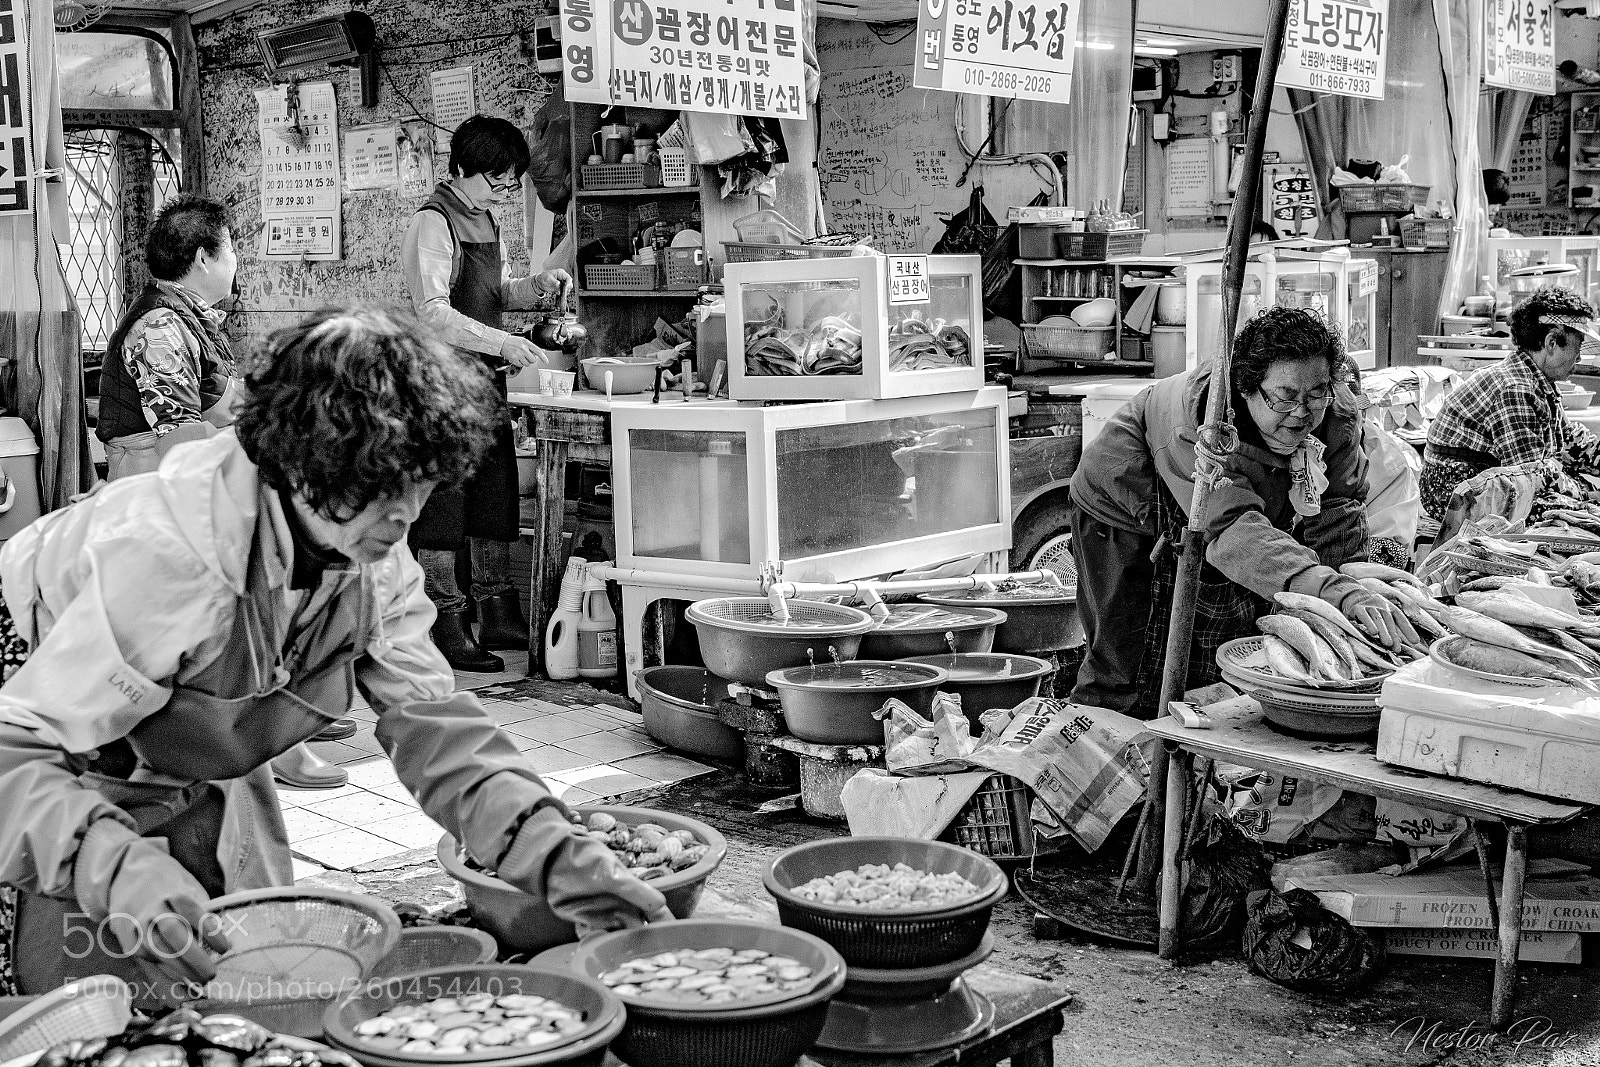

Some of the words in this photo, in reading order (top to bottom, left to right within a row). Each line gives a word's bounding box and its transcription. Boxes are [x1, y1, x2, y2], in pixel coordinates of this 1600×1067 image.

[986, 0, 1068, 60] 이모집
[1301, 0, 1384, 56] 노랑모자
[964, 67, 1052, 94] 010-2868-2026
[314, 126, 319, 135] 4
[324, 126, 328, 134] 5
[267, 147, 271, 155] 6
[276, 146, 280, 155] 7
[285, 145, 290, 154] 8
[304, 144, 311, 153] 10
[314, 143, 321, 152] 11
[323, 143, 331, 152] 12
[267, 164, 273, 172] 13
[276, 163, 282, 172] 14
[284, 163, 292, 171] 15
[294, 162, 301, 171] 16
[304, 161, 311, 170] 17
[314, 161, 322, 170] 18
[324, 160, 332, 169] 19
[267, 181, 274, 189] 20
[277, 180, 283, 189] 21
[285, 180, 293, 188] 22
[294, 179, 303, 188] 23
[305, 179, 313, 188] 24
[315, 178, 323, 187] 25
[326, 177, 334, 187] 26
[266, 197, 273, 206] 27
[276, 197, 283, 205] 28
[285, 196, 294, 205] 29
[296, 196, 304, 205] 30
[306, 196, 314, 205] 31
[896, 261, 920, 274] 국내산
[1422, 902, 1479, 914] FROZEN
[1548, 919, 1591, 930] CHINA
[1440, 940, 1459, 950] OF
[1465, 940, 1499, 952] CHIN
